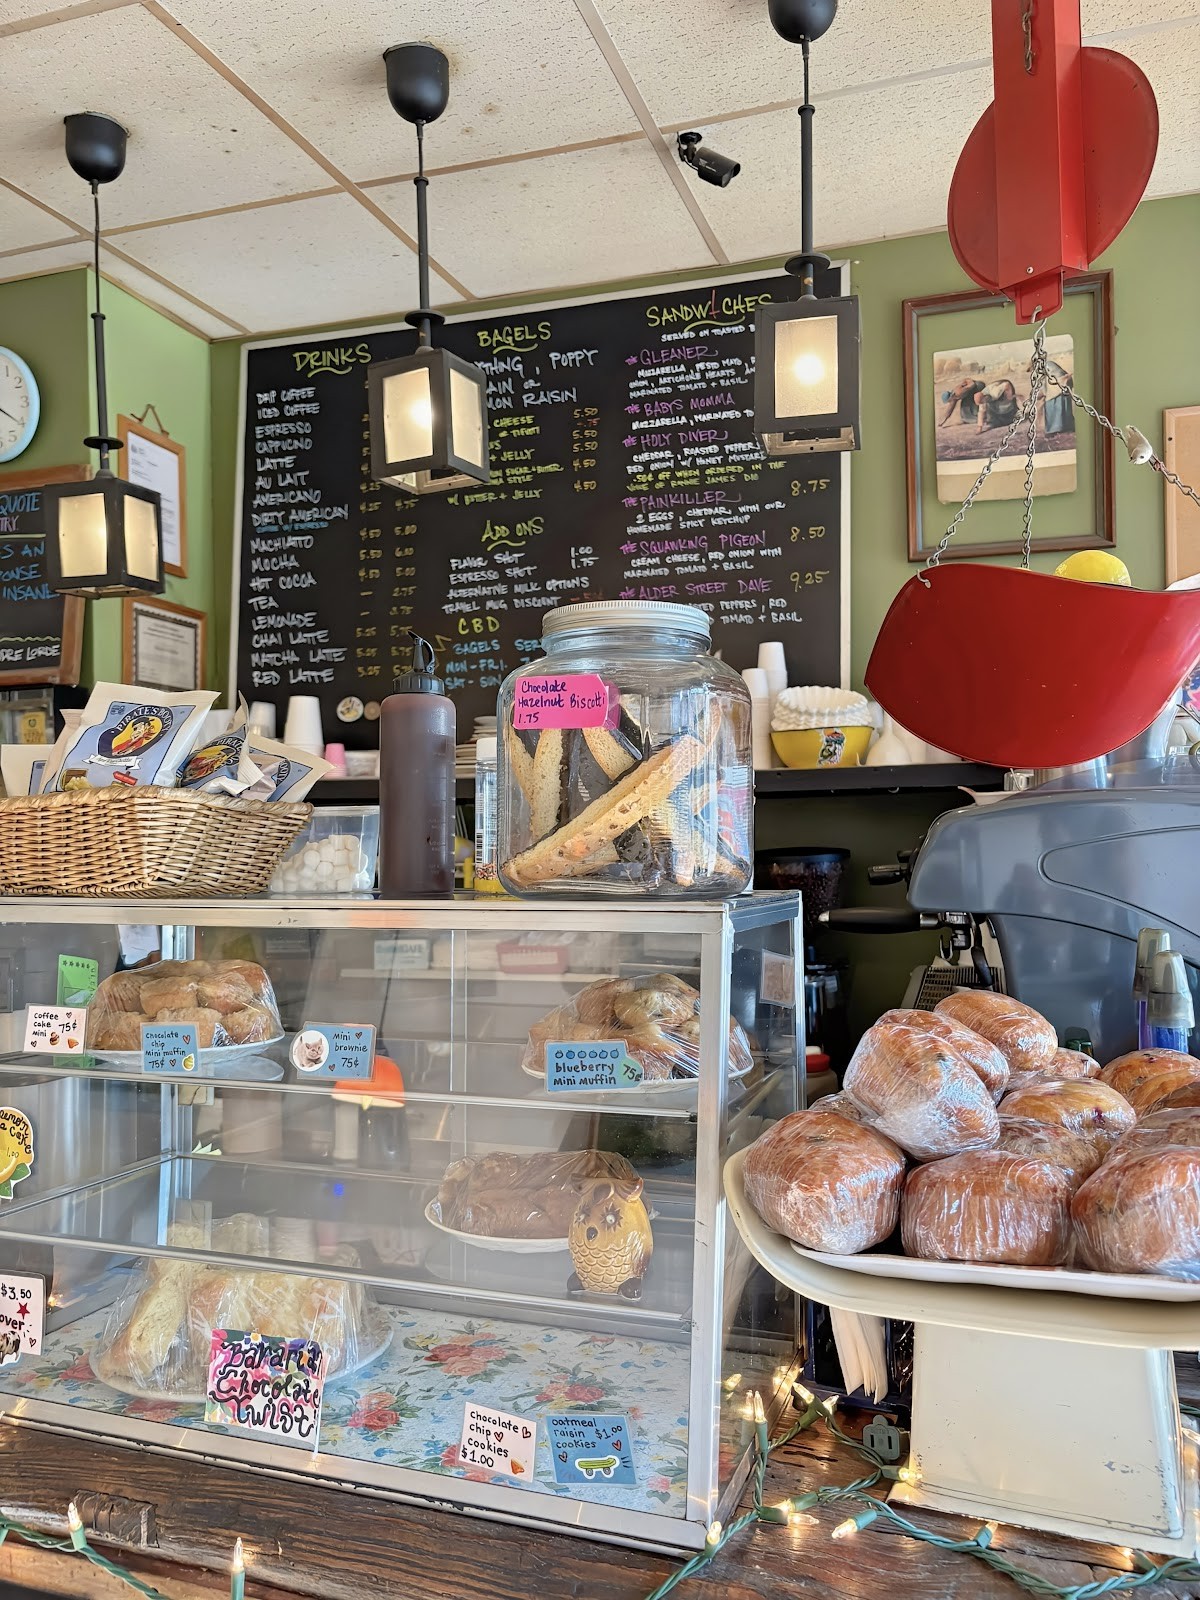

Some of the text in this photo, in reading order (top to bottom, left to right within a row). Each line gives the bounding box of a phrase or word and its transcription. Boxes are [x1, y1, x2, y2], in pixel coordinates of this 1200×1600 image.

[477, 322, 552, 347] BAGELS
[661, 325, 746, 342] SERVED TOASTED
[293, 343, 372, 371] DRINKS
[549, 349, 598, 369] POPPY
[640, 345, 719, 366] GLEANER
[695, 361, 720, 373] PESTO
[14, 376, 22, 389] 2
[21, 395, 30, 409] 3
[522, 387, 577, 408] RAISIN
[644, 399, 683, 417] BABYS
[690, 392, 736, 411] MOMMA
[493, 407, 598, 427] CHEESE 5.50
[8, 430, 18, 442] 5
[255, 421, 312, 438] ESPRESSO
[572, 430, 598, 439] 5.50
[572, 441, 598, 452] 5.50
[641, 432, 672, 451] HOLY
[679, 429, 729, 445] DIVER
[501, 448, 535, 461] JELLY
[683, 445, 720, 457] ROASTED
[256, 455, 297, 472] LATTE
[626, 464, 645, 475] RED
[767, 461, 787, 470] THE
[255, 470, 309, 491] AU LAIT
[705, 475, 736, 485] JAMES
[252, 488, 321, 508] AMERICANO
[512, 489, 543, 500] JELLY
[621, 479, 831, 513] THE PAINKILLER 8.75
[0, 492, 42, 516] QUOTE
[635, 514, 645, 523] 2
[738, 504, 760, 513] WITH
[764, 501, 786, 510] OUR
[251, 504, 349, 527] DIRTY AMERICAN
[711, 515, 751, 526] KETCHUP
[481, 517, 544, 542] ADD ONS
[21, 541, 45, 557] AN
[619, 526, 825, 556] THE SQUAWKING PIGEON 8.50
[251, 554, 299, 573] MOCHA
[494, 551, 525, 564] SHOT
[571, 546, 593, 558] 1.00
[631, 557, 660, 568] CREAM
[708, 551, 725, 561] RED
[760, 547, 782, 557] WITH
[449, 557, 599, 585] ESPRESSO SHOT 1.75
[249, 571, 317, 592] HOT COCOA
[446, 576, 590, 600] ALTERNATIVE MILK OPTIONS
[639, 585, 679, 600] ALDER
[685, 582, 728, 595] STREET
[738, 578, 773, 594] DAVE
[790, 570, 830, 592] 9.25
[248, 596, 279, 612] TEA
[442, 601, 480, 615] TRAVEL
[486, 599, 508, 611] MUG
[513, 596, 562, 609] DISCOUNT
[768, 598, 787, 609] RED
[252, 612, 317, 631] LEMONADE
[720, 611, 802, 624] TOMATO BASIL
[252, 630, 330, 648] CHAI LATTE
[453, 639, 500, 655] BAGELS
[27, 645, 60, 661] LORDE
[251, 648, 348, 668] MATCHA LATTE
[252, 667, 335, 688] RED LATTE
[521, 679, 567, 694] Chocolate
[518, 692, 606, 709] Hazelnut Biscotti
[116, 706, 159, 732] PIRATE'S
[157, 708, 172, 733] BOOTY
[518, 711, 540, 724] 1.75
[58, 1019, 77, 1034] 75¢
[151, 1040, 165, 1051] chip
[335, 1042, 368, 1052] brownie
[149, 1057, 164, 1068] 75¢
[341, 1057, 359, 1068] 75¢
[555, 1060, 642, 1082] blueberry 75¢
[1, 1283, 32, 1300] $3.50
[216, 1369, 320, 1409] Chocolate
[469, 1422, 491, 1440] chip
[470, 1411, 519, 1433] chocolate
[552, 1417, 597, 1428] oatmeal
[554, 1425, 623, 1440] raisin $1.00
[467, 1437, 509, 1458] cookies
[556, 1439, 597, 1450] cookies
[461, 1445, 494, 1467] $1.00
